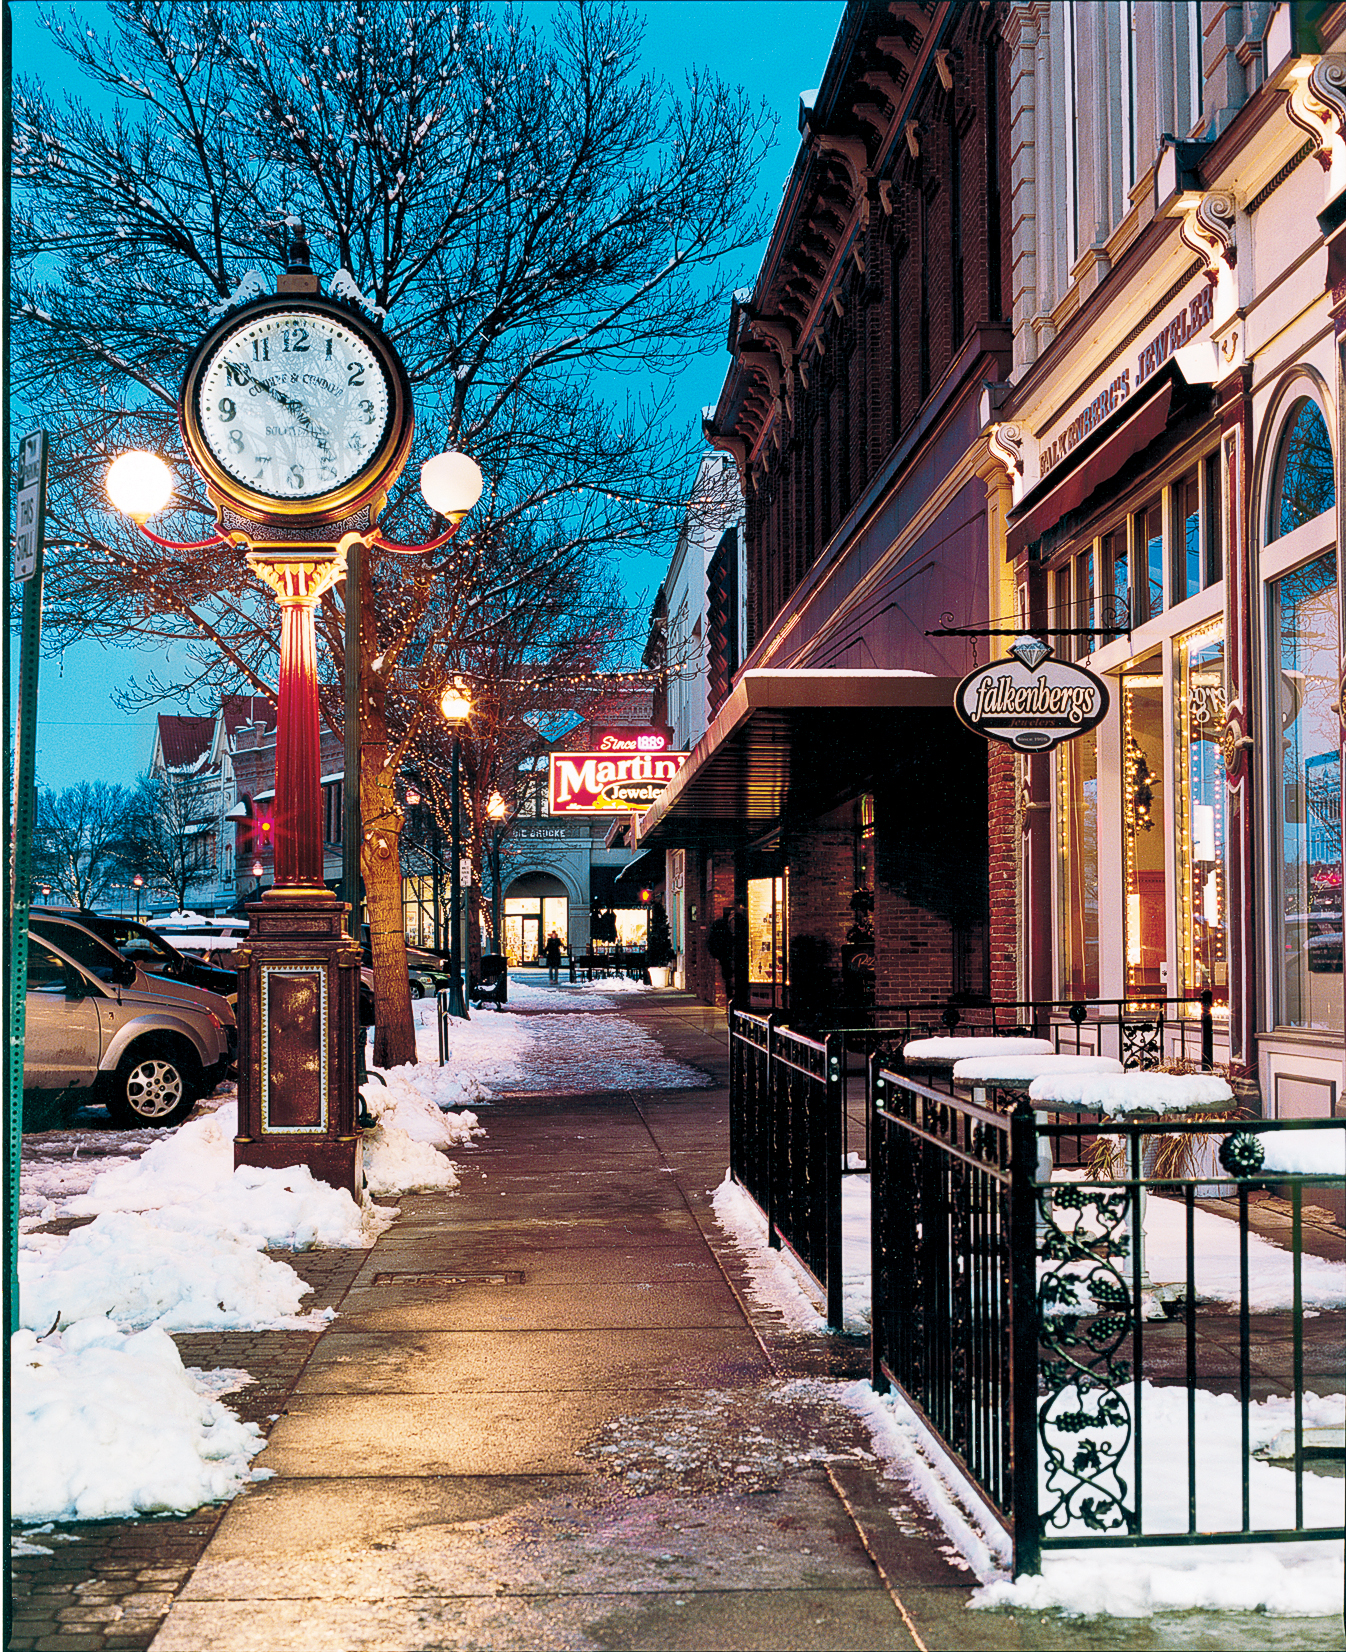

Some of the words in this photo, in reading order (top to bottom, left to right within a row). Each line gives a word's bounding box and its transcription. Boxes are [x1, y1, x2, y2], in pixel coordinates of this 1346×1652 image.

[250, 337, 271, 361] 11
[281, 327, 311, 353] 12
[325, 338, 333, 361] 1
[347, 362, 366, 387] 2
[218, 397, 237, 422] 9
[358, 399, 377, 425] 3
[228, 429, 245, 454] 8
[972, 675, 1094, 723] falkenbergs
[601, 736, 637, 750] Since
[637, 736, 664, 749] 1889
[556, 755, 686, 802] Martin'
